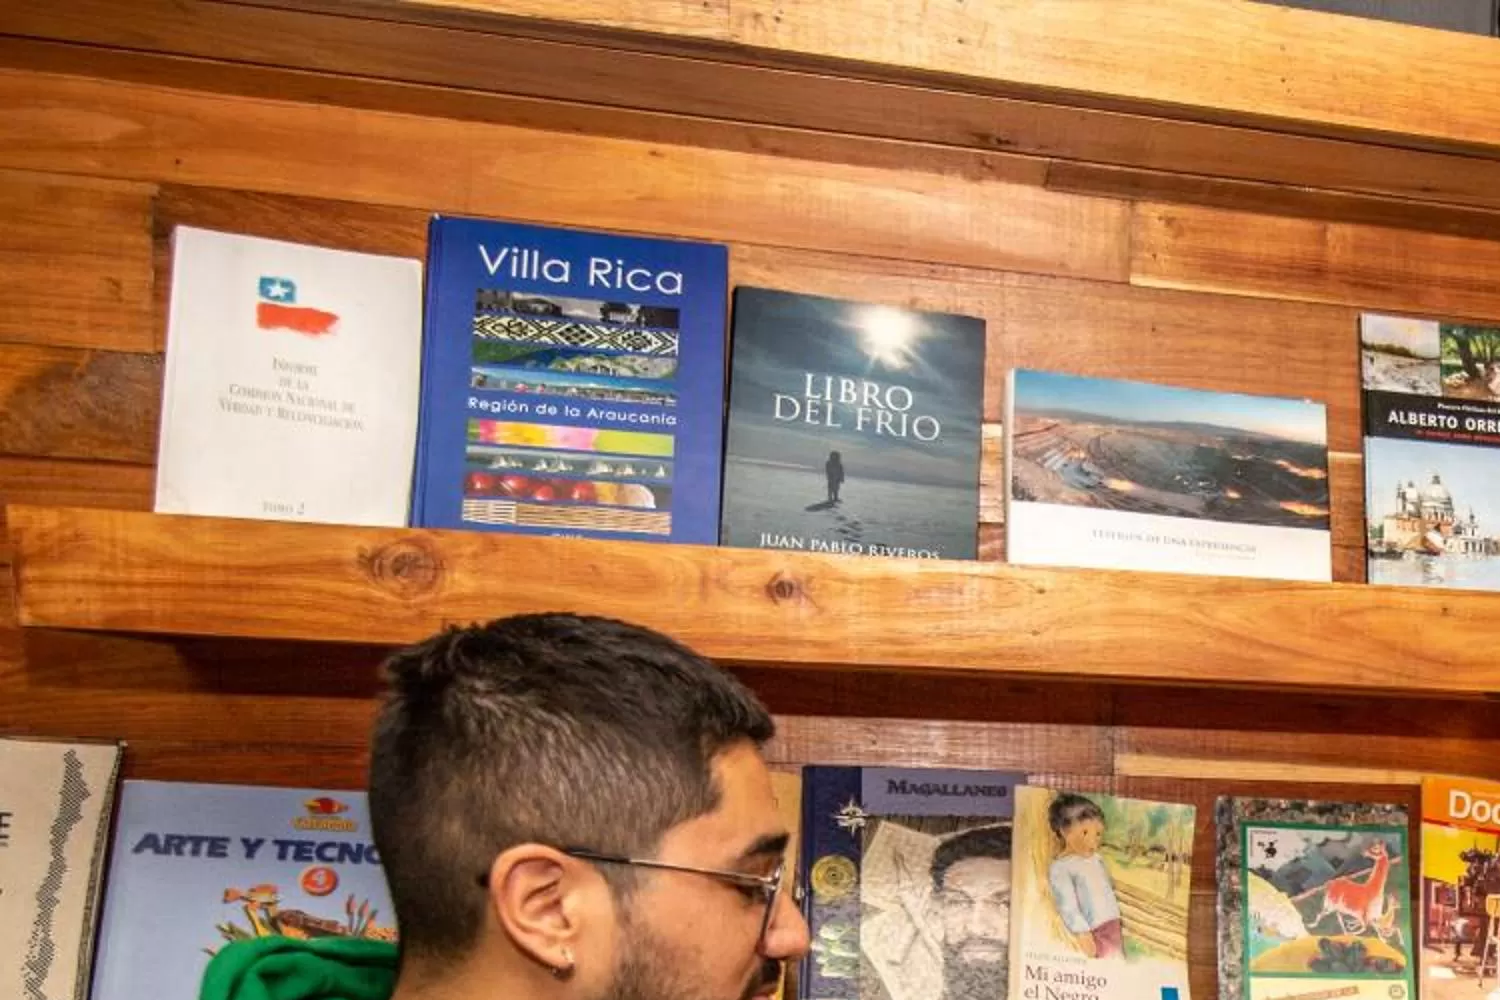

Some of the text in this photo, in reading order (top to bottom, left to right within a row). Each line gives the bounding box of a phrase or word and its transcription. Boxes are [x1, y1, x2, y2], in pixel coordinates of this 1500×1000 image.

[478, 244, 683, 295] Villa Rica
[467, 396, 529, 414] Región
[535, 403, 557, 416] de
[564, 405, 581, 417] la
[804, 373, 913, 412] LIBRO
[774, 393, 842, 428] DEL
[1388, 410, 1458, 430] ALBERTO
[759, 532, 941, 560] JUAN PABLO RIVEROS
[132, 832, 381, 864] ARTE Y TECNO
[1025, 964, 1107, 990] Mi amigo
[1024, 984, 1039, 999] el
